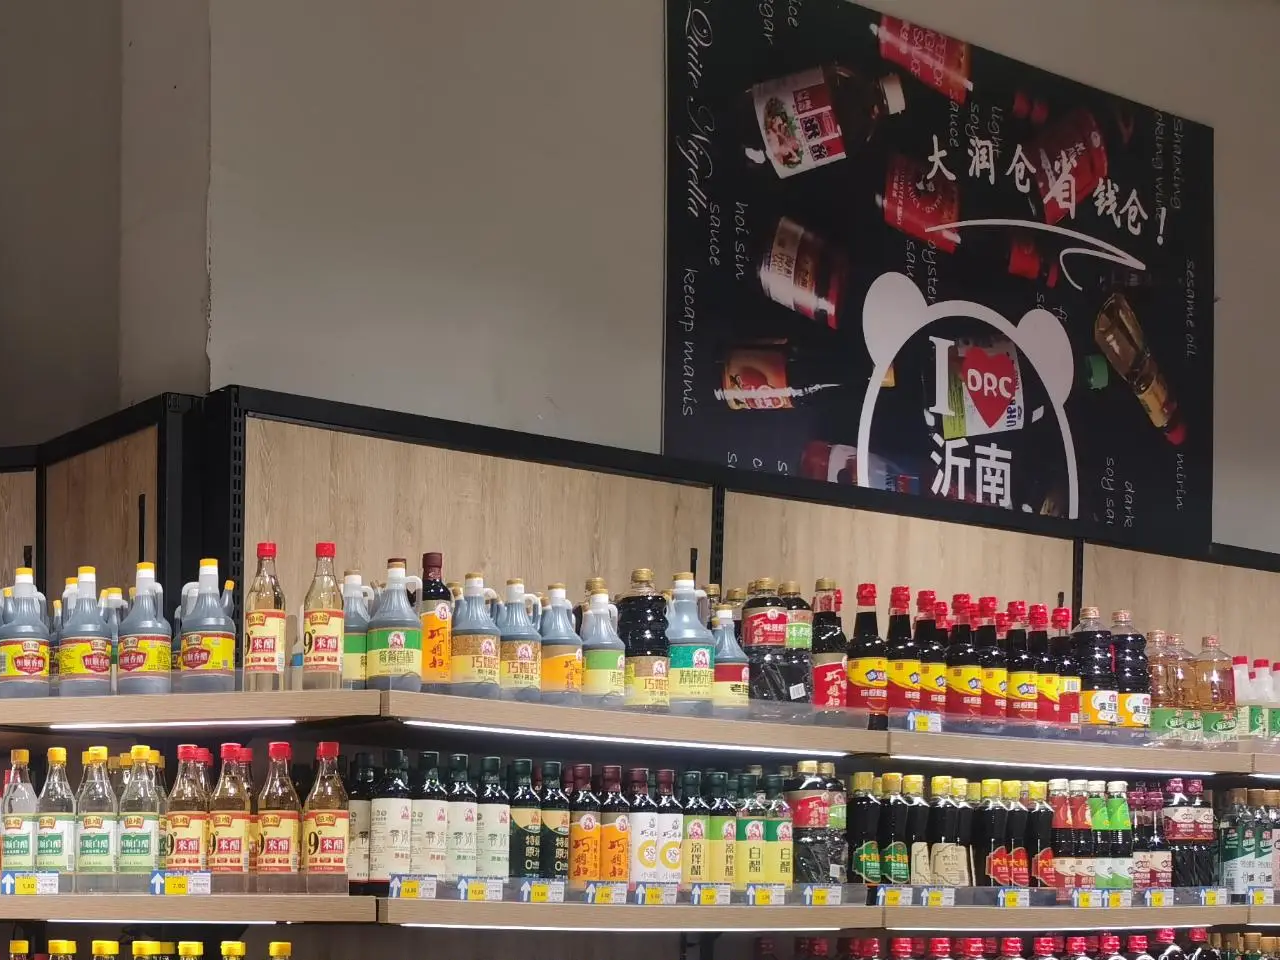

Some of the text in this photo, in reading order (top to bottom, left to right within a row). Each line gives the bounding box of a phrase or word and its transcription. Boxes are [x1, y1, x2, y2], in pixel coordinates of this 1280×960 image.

[709, 203, 721, 266] sauce
[929, 336, 955, 416] I
[930, 433, 1013, 510] 沂南
[253, 638, 276, 651] 米醋
[177, 839, 200, 851] 米醋
[220, 839, 241, 851] 米醋
[268, 839, 289, 851] 米醋
